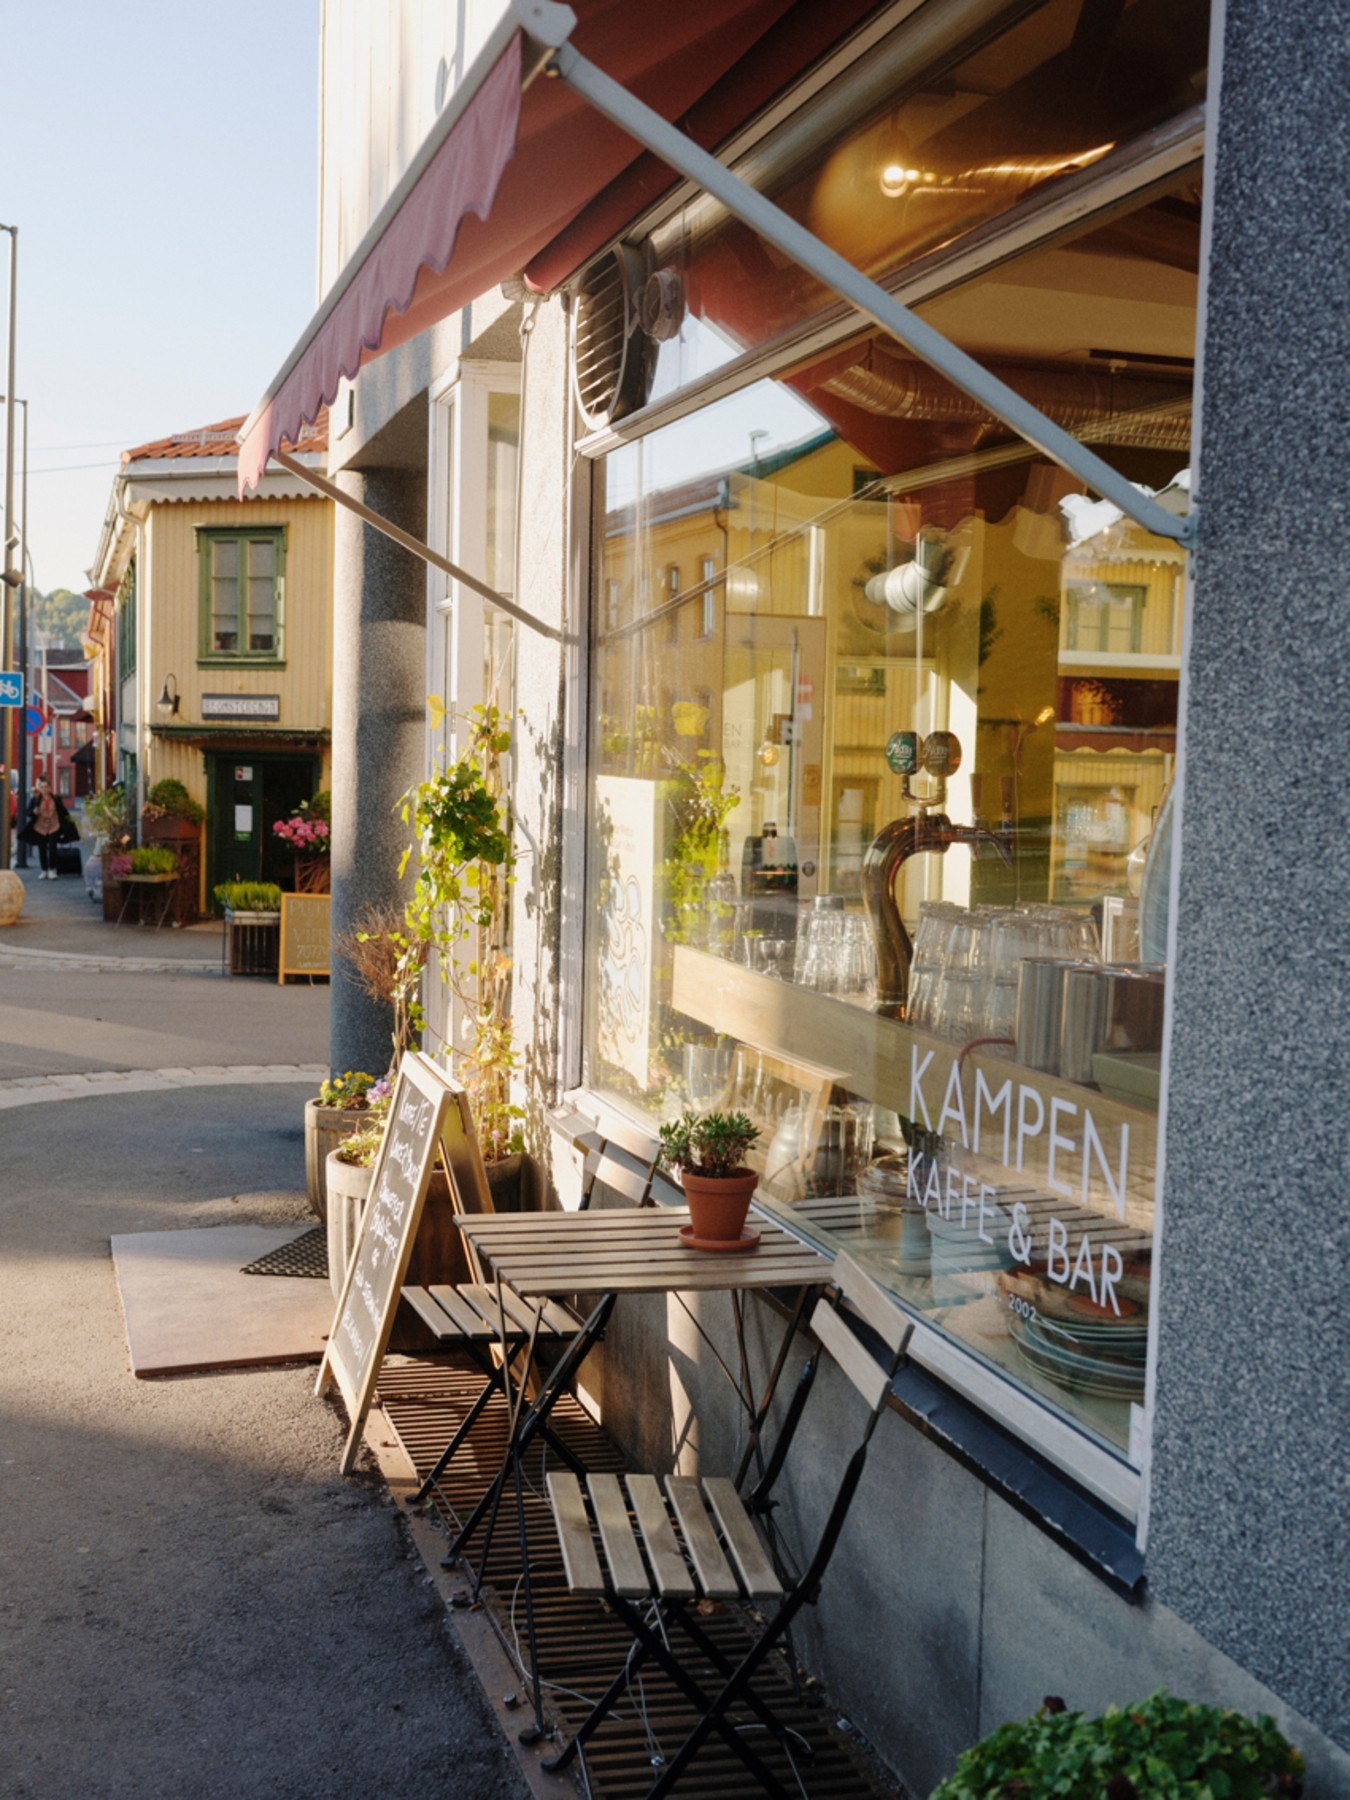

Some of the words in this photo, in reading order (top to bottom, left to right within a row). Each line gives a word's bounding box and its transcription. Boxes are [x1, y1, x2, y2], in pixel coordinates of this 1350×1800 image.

[910, 1043, 1130, 1222] KAMPEN
[906, 1146, 997, 1244] KAFFE
[1008, 1202, 1032, 1266] &
[1047, 1217, 1123, 1317] BAR
[1008, 1294, 1037, 1323] 2002
